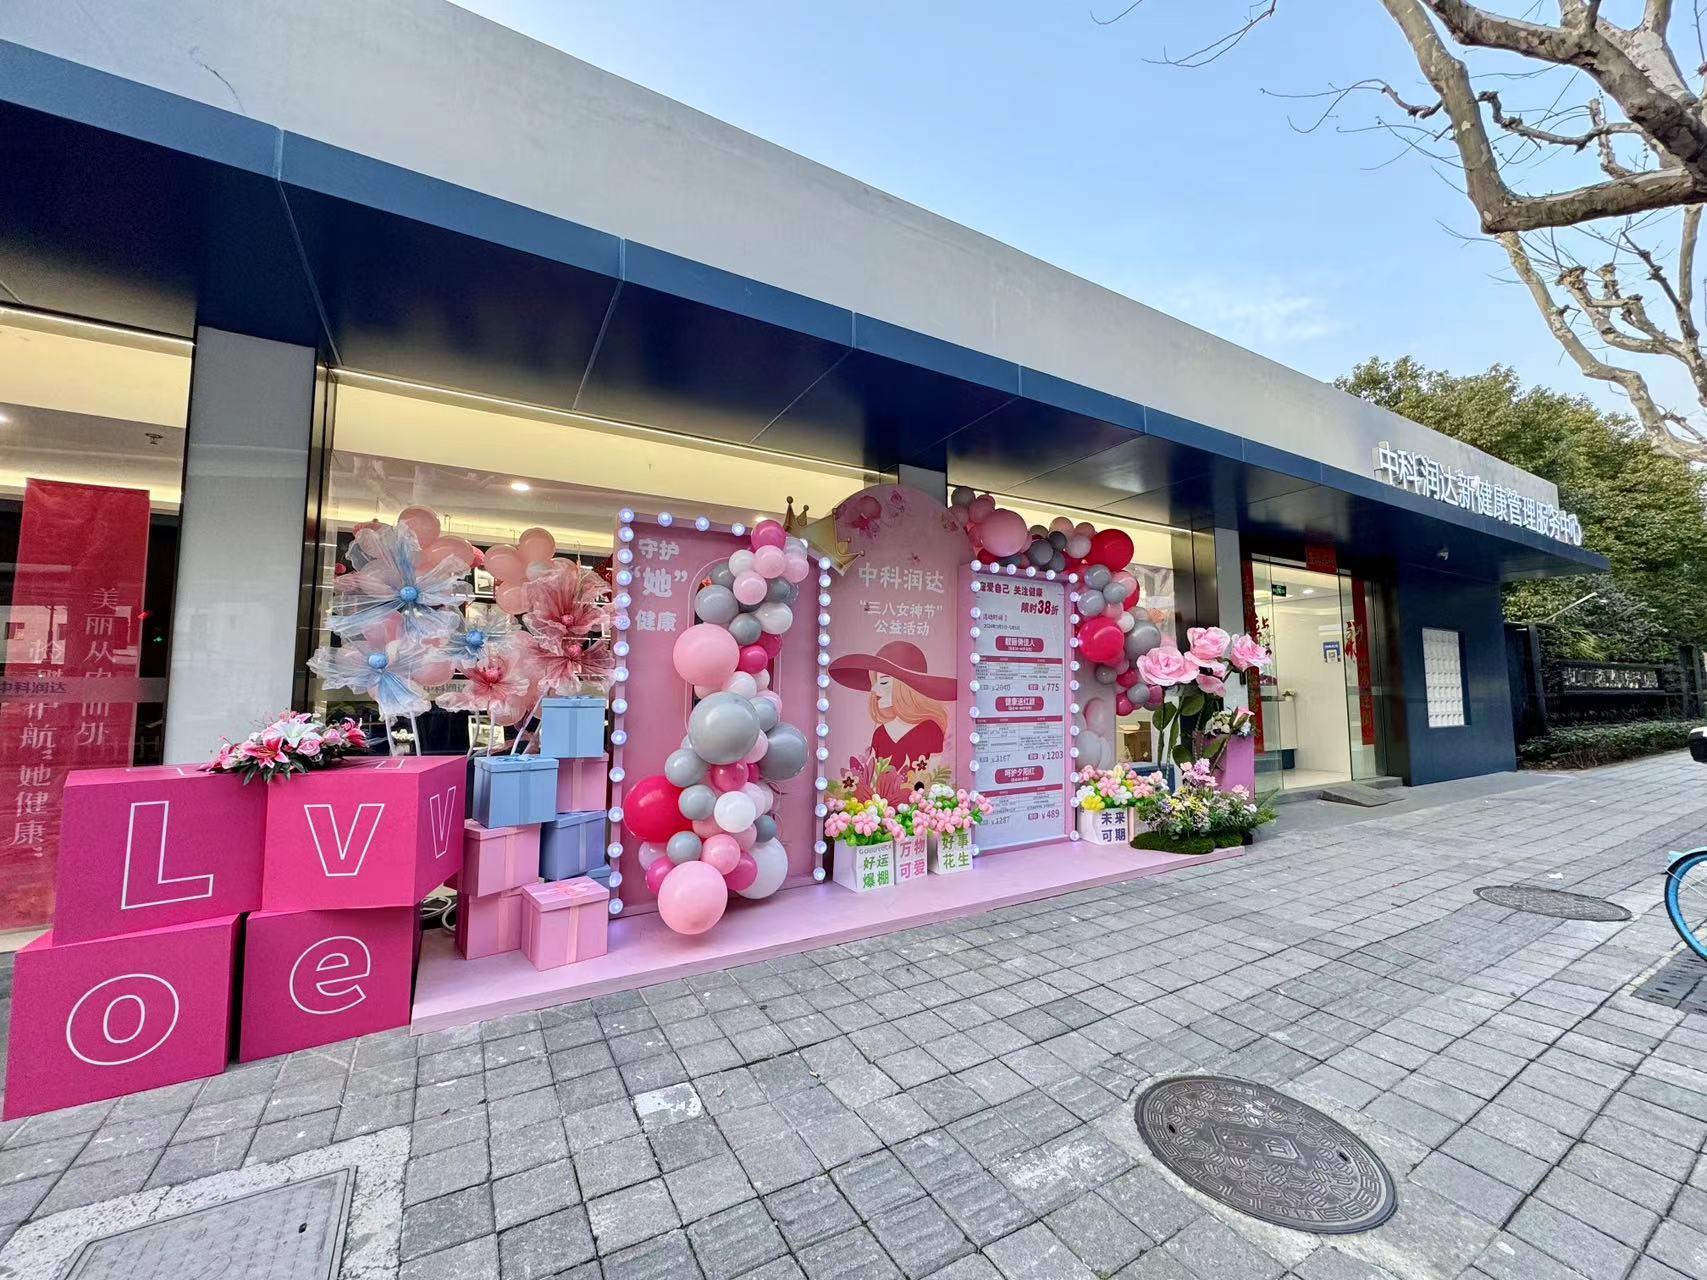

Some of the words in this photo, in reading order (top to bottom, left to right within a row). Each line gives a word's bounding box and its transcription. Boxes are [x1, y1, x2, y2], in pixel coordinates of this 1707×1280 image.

[1377, 444, 1583, 546] 中科润达新健康管理服务中心
[638, 538, 680, 560] 守护
[858, 562, 945, 594] 中科润达
[1021, 600, 1059, 615] 限时38折
[635, 609, 677, 632] 健康
[874, 619, 930, 636] 公益活动
[1101, 812, 1125, 825] 未来
[942, 833, 969, 851] 好事
[1101, 828, 1126, 842] 可期
[121, 800, 214, 910] L
[900, 838, 926, 858] 万物
[863, 854, 889, 871] 好运
[900, 859, 926, 879] 可爱
[943, 852, 970, 869] 花生
[289, 935, 371, 1014] e
